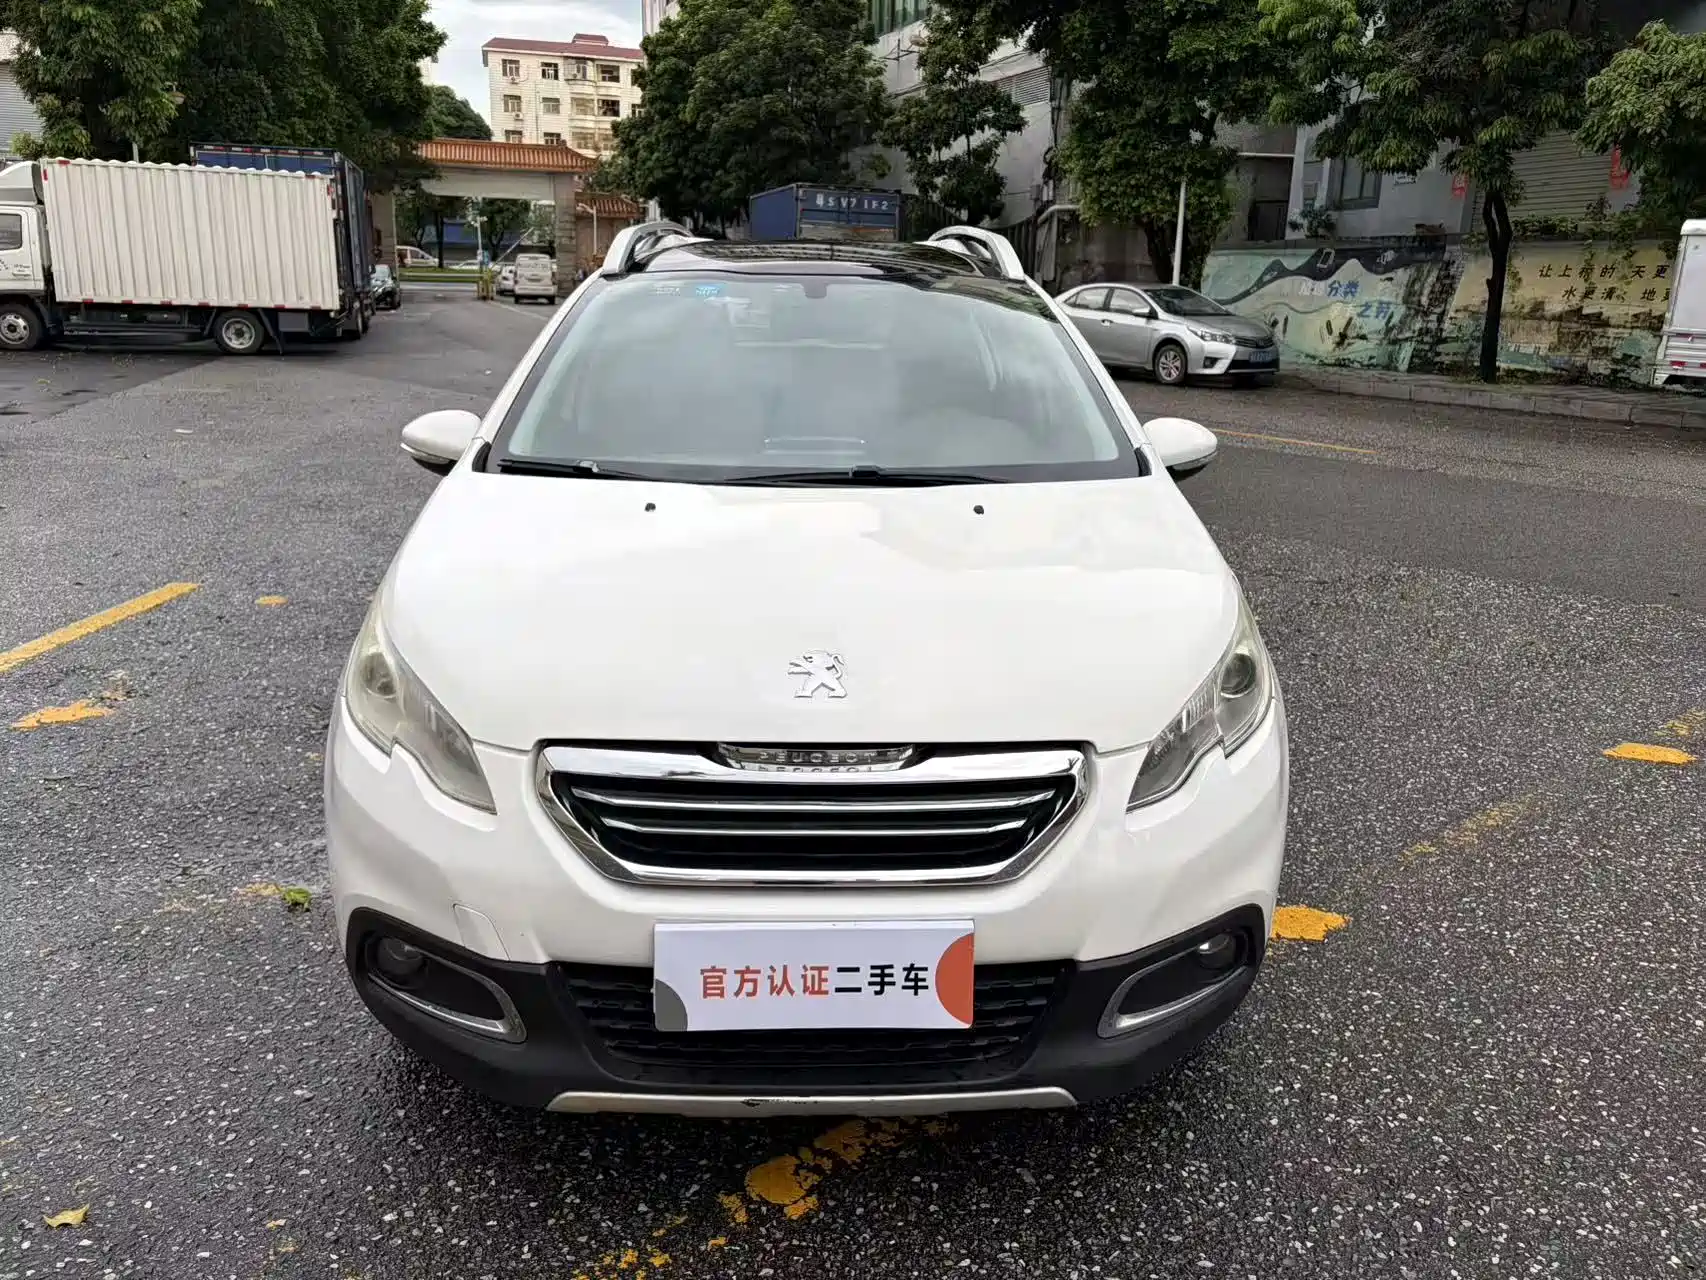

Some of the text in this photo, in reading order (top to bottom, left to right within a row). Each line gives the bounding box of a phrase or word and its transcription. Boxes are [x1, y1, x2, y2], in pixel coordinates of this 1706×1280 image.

[700, 963, 929, 999] 官方认证二手车
